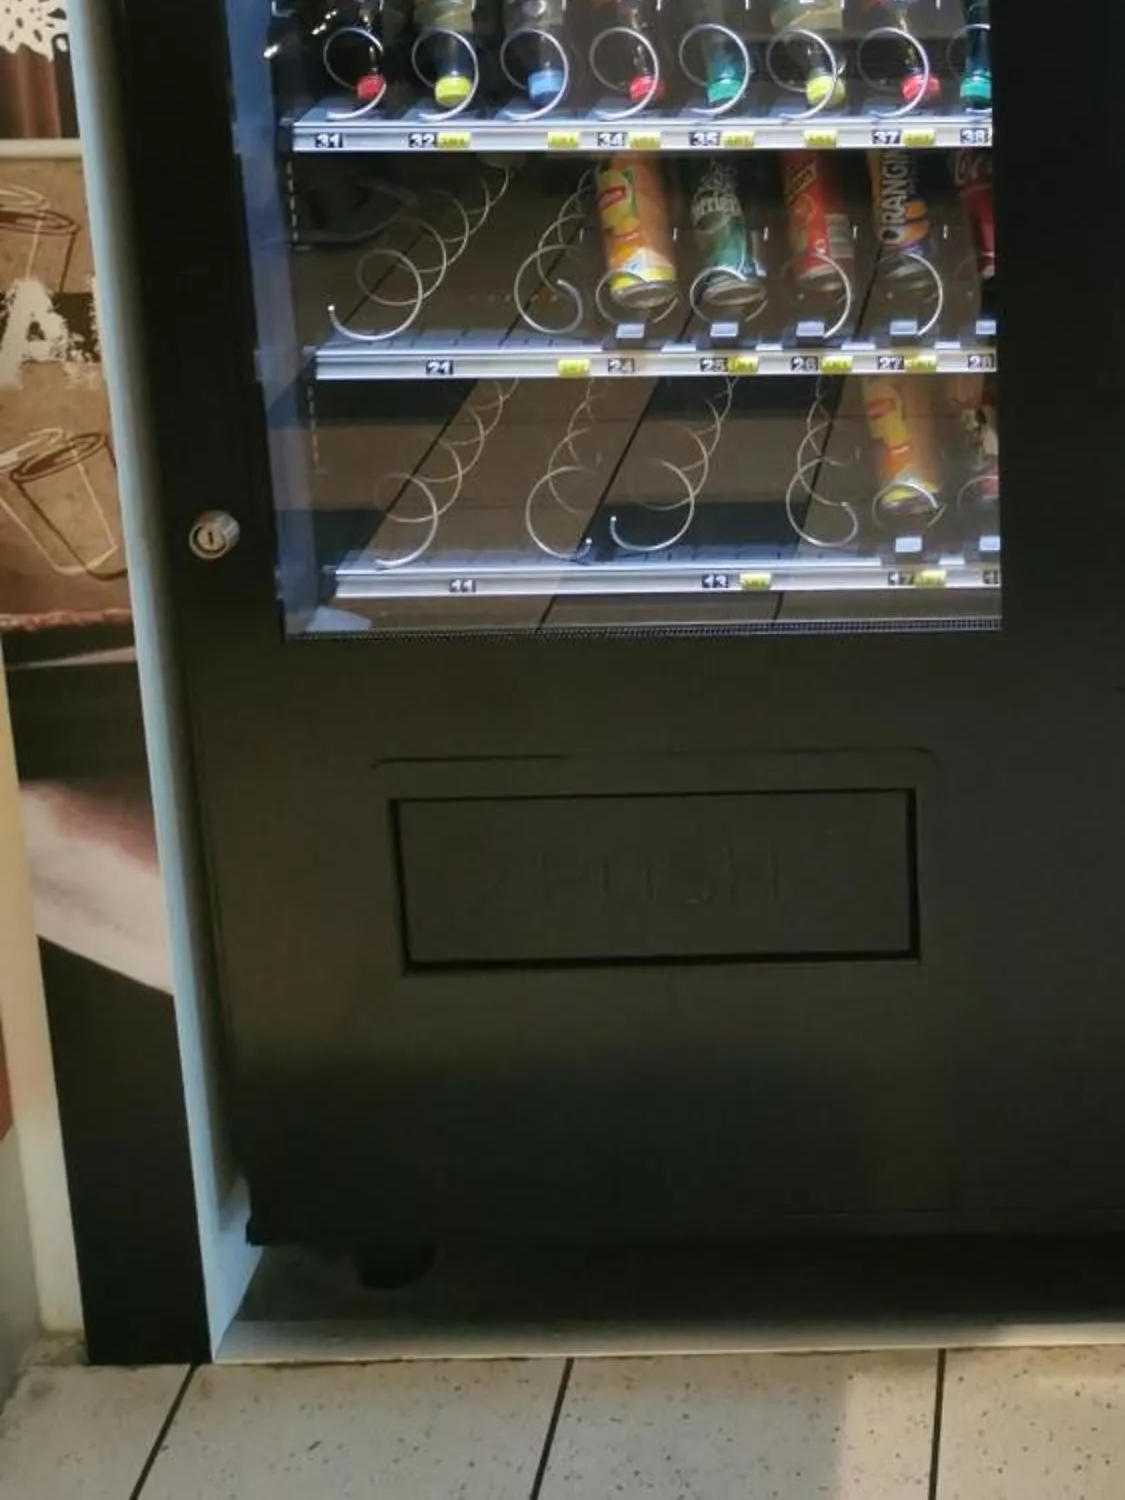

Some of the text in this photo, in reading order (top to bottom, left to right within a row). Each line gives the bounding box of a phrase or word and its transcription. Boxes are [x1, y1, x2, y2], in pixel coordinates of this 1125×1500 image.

[314, 132, 343, 148] 31
[409, 132, 436, 148] 32
[598, 132, 626, 147] 34
[690, 131, 720, 147] 35
[872, 129, 900, 145] 37
[960, 129, 989, 145] 38
[426, 359, 454, 375] 21
[700, 357, 728, 373] 25
[791, 356, 819, 372] 26
